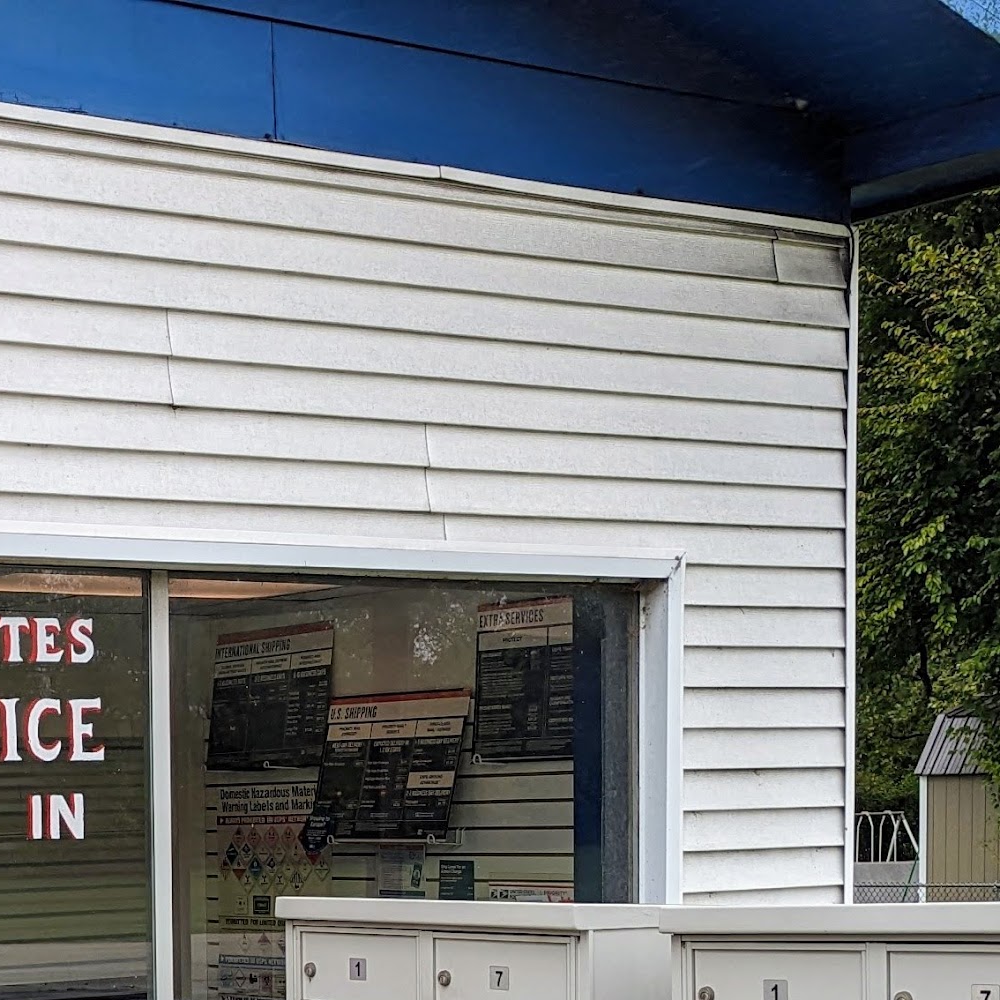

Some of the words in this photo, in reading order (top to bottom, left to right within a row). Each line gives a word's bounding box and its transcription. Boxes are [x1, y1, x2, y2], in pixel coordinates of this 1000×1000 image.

[505, 609, 544, 625] SERVICES
[215, 642, 259, 659] INTERNATIONAL
[262, 639, 290, 653] SHIPPING
[330, 708, 342, 720] U.S.
[345, 706, 378, 719] SHIPPING
[220, 788, 250, 799] Domestic
[251, 787, 289, 798] Hazardous
[222, 802, 248, 814] Warning
[250, 800, 273, 811] Labels
[275, 800, 288, 810] and
[28, 793, 85, 840] IN
[354, 961, 361, 978] 1
[495, 970, 503, 987] 7
